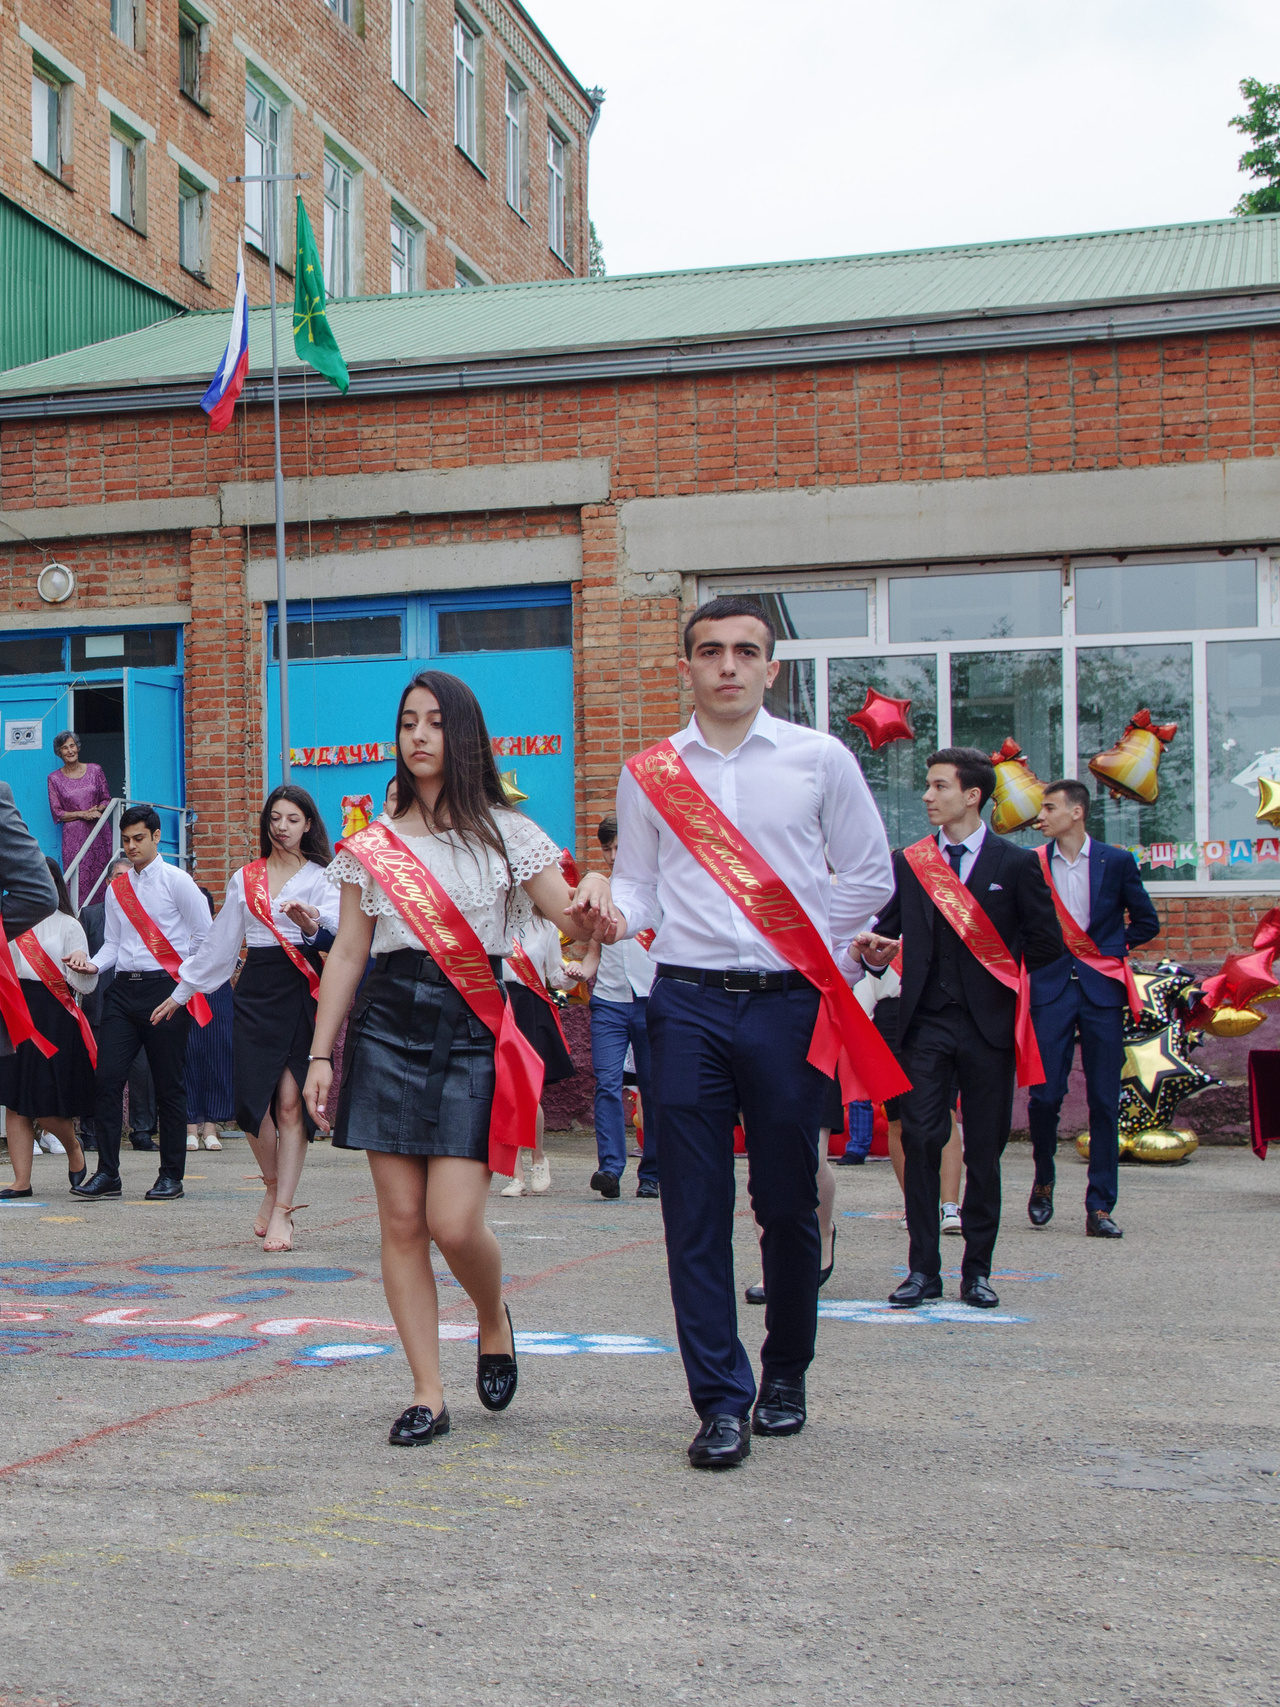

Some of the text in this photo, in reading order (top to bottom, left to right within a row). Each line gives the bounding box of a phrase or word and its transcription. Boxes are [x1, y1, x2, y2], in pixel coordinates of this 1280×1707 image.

[492, 735, 562, 756] КНИК!
[664, 784, 807, 934] Выпускник 2021
[1152, 840, 1276, 862] ШКОЛА
[373, 850, 499, 994] Выпускник 2021
[923, 863, 983, 936] Выпускник
